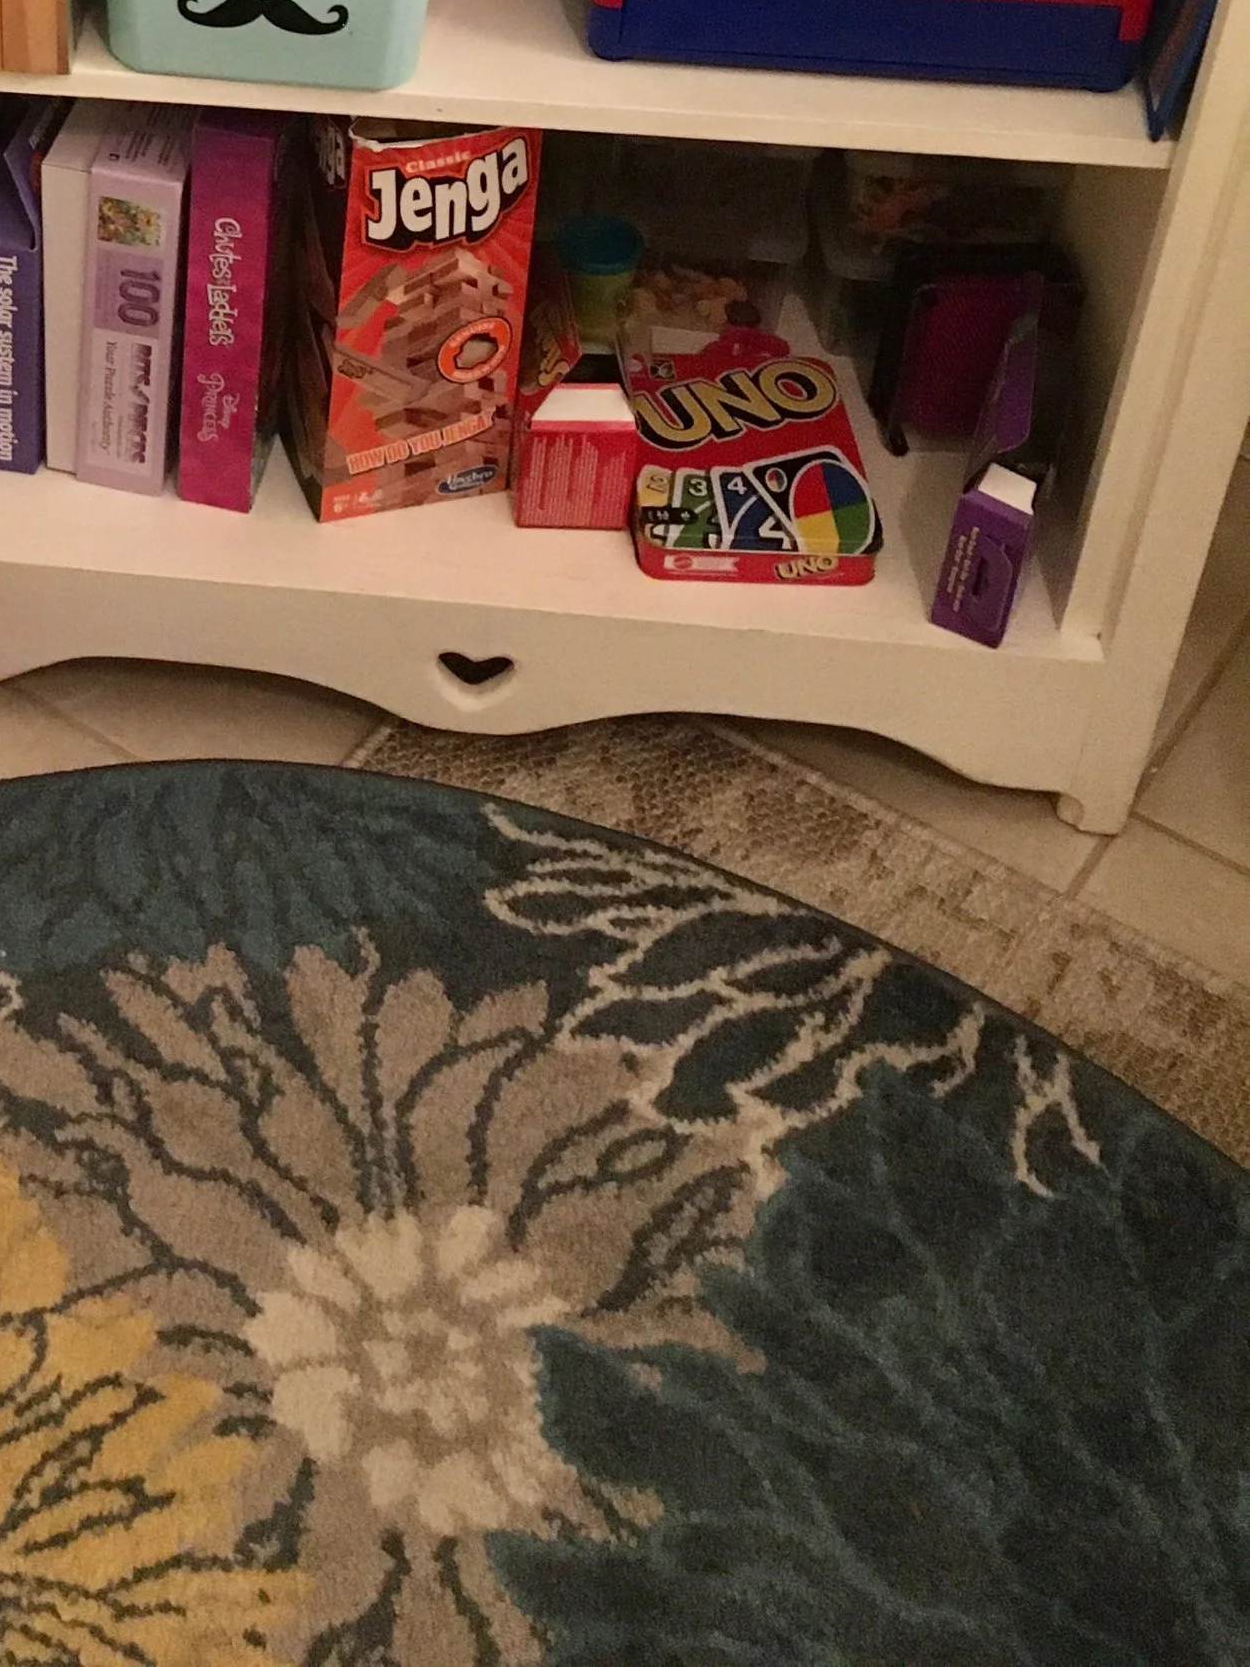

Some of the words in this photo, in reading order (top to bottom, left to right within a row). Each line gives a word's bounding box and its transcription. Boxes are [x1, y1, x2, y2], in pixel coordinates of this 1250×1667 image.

[405, 150, 471, 174] Classic
[367, 136, 528, 241] Jenga
[210, 217, 243, 279] Chutes
[118, 269, 161, 328] 100
[207, 283, 239, 347] Ladders
[105, 341, 118, 367] Your
[103, 367, 117, 400] Puzzle
[196, 372, 225, 442] Princess
[634, 359, 836, 444] UNO
[100, 400, 114, 452] Authority
[349, 447, 385, 475] HOW
[385, 440, 408, 464] DO
[410, 431, 442, 454] YOU
[688, 479, 708, 497] 3
[727, 476, 747, 495] 4
[776, 557, 836, 580] UNO
